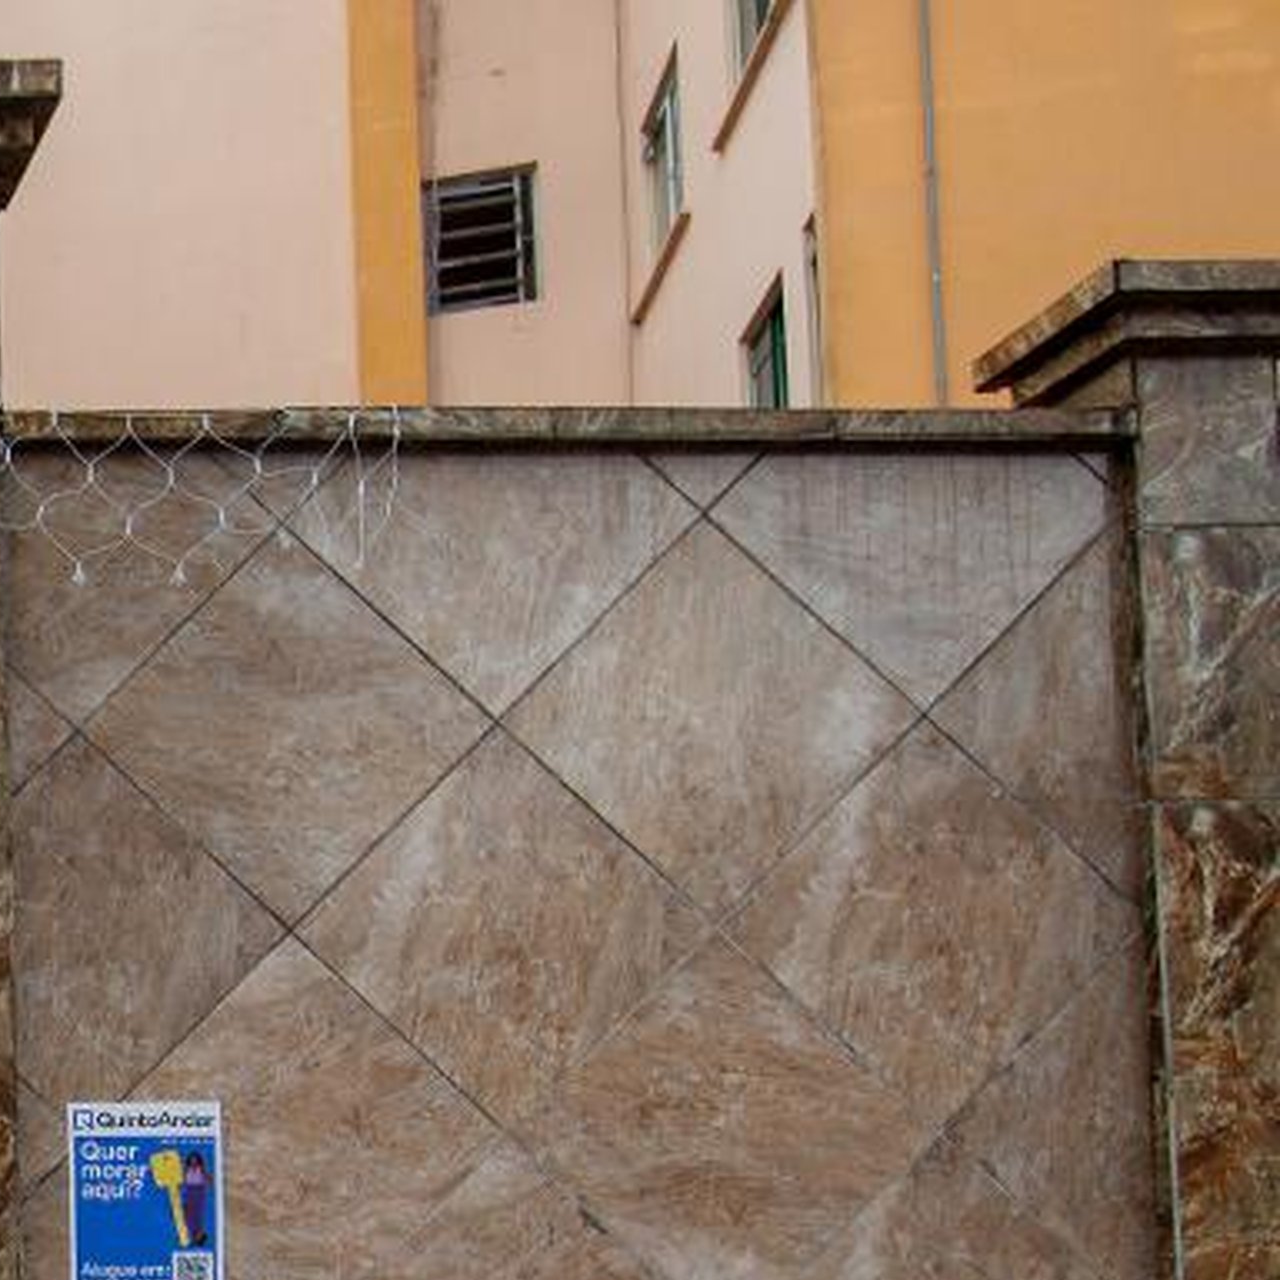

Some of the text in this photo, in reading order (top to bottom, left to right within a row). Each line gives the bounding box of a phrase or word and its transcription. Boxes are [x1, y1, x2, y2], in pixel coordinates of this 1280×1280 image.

[96, 1111, 215, 1128] QuintoAndar
[80, 1140, 140, 1161] Quer
[81, 1163, 149, 1180] morar
